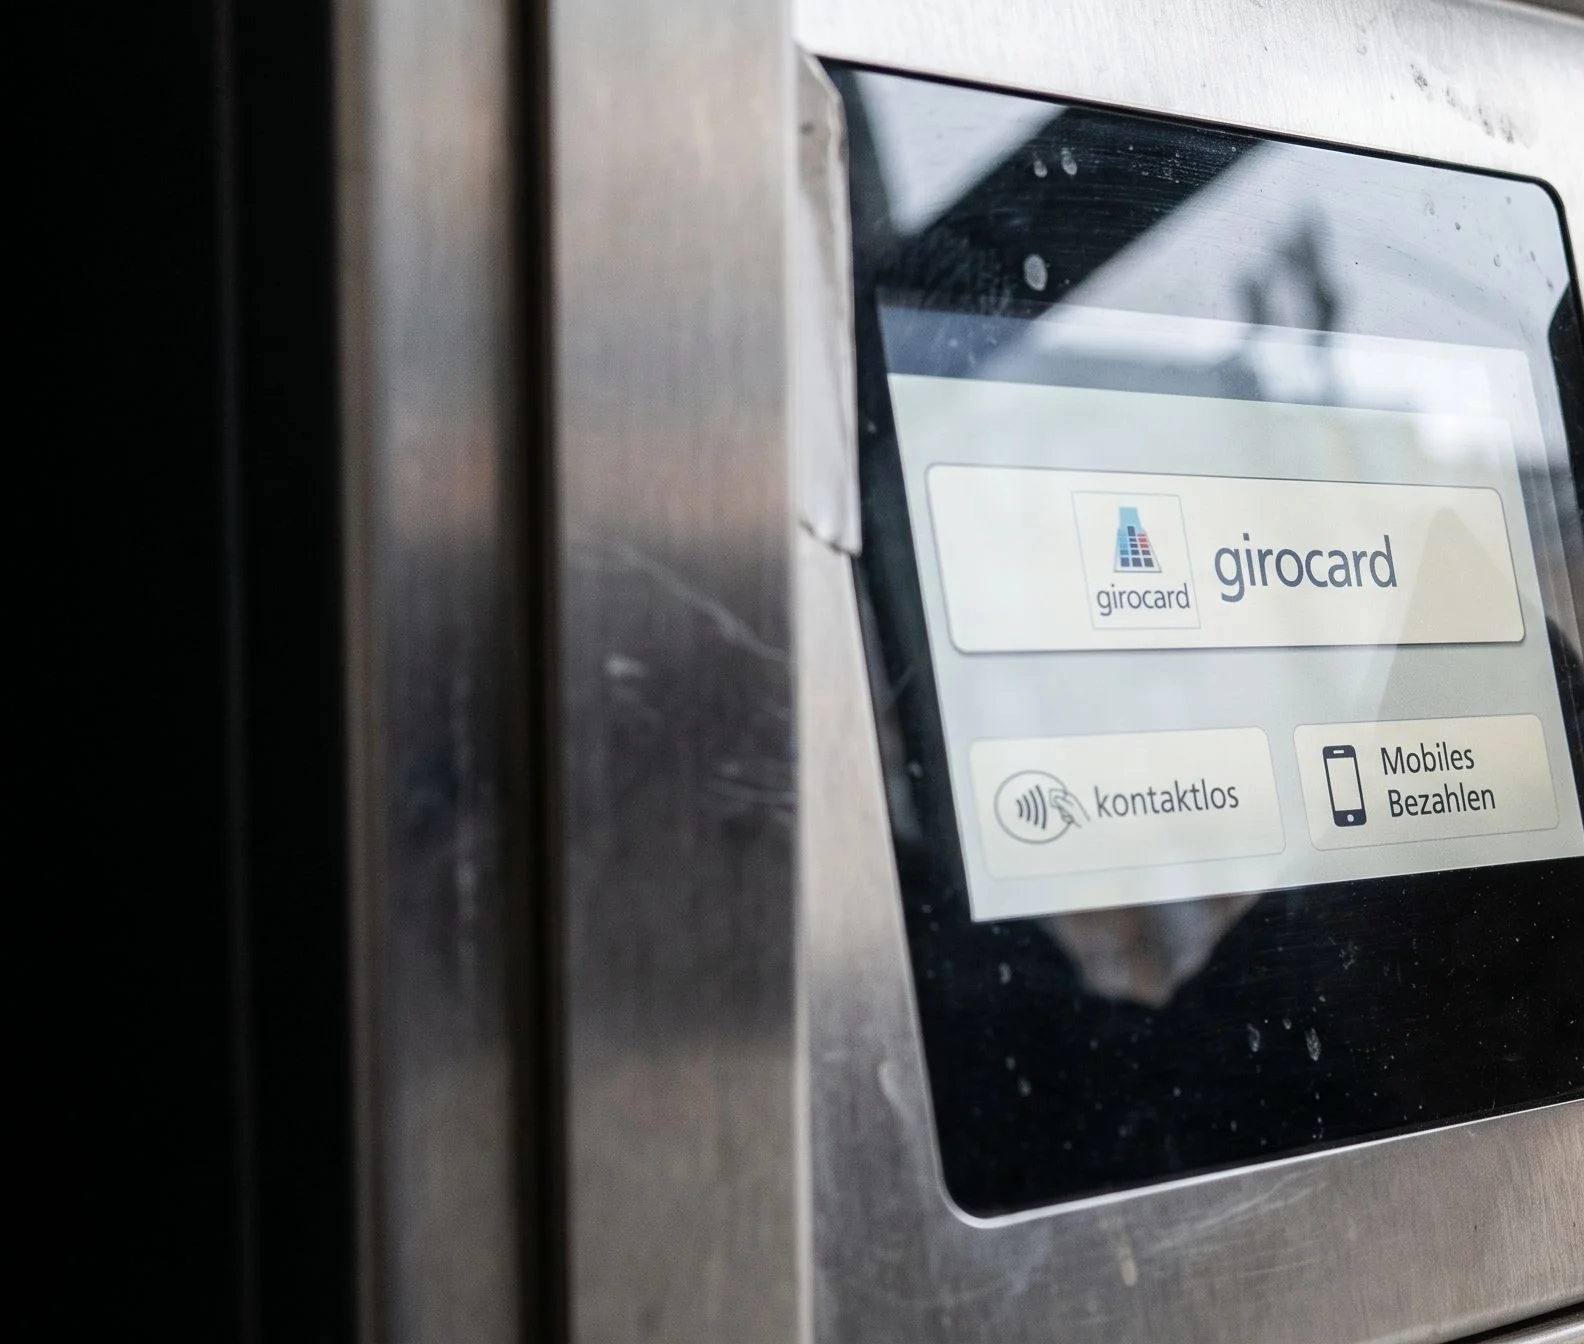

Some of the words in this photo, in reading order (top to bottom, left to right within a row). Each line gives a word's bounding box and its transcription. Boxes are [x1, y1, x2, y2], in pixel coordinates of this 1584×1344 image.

[1213, 533, 1398, 603] girocard
[1096, 582, 1191, 616] girocard
[1381, 742, 1475, 776] Mobiles
[1093, 778, 1240, 818] kontaktlos
[1388, 783, 1496, 818] Bezahlen
